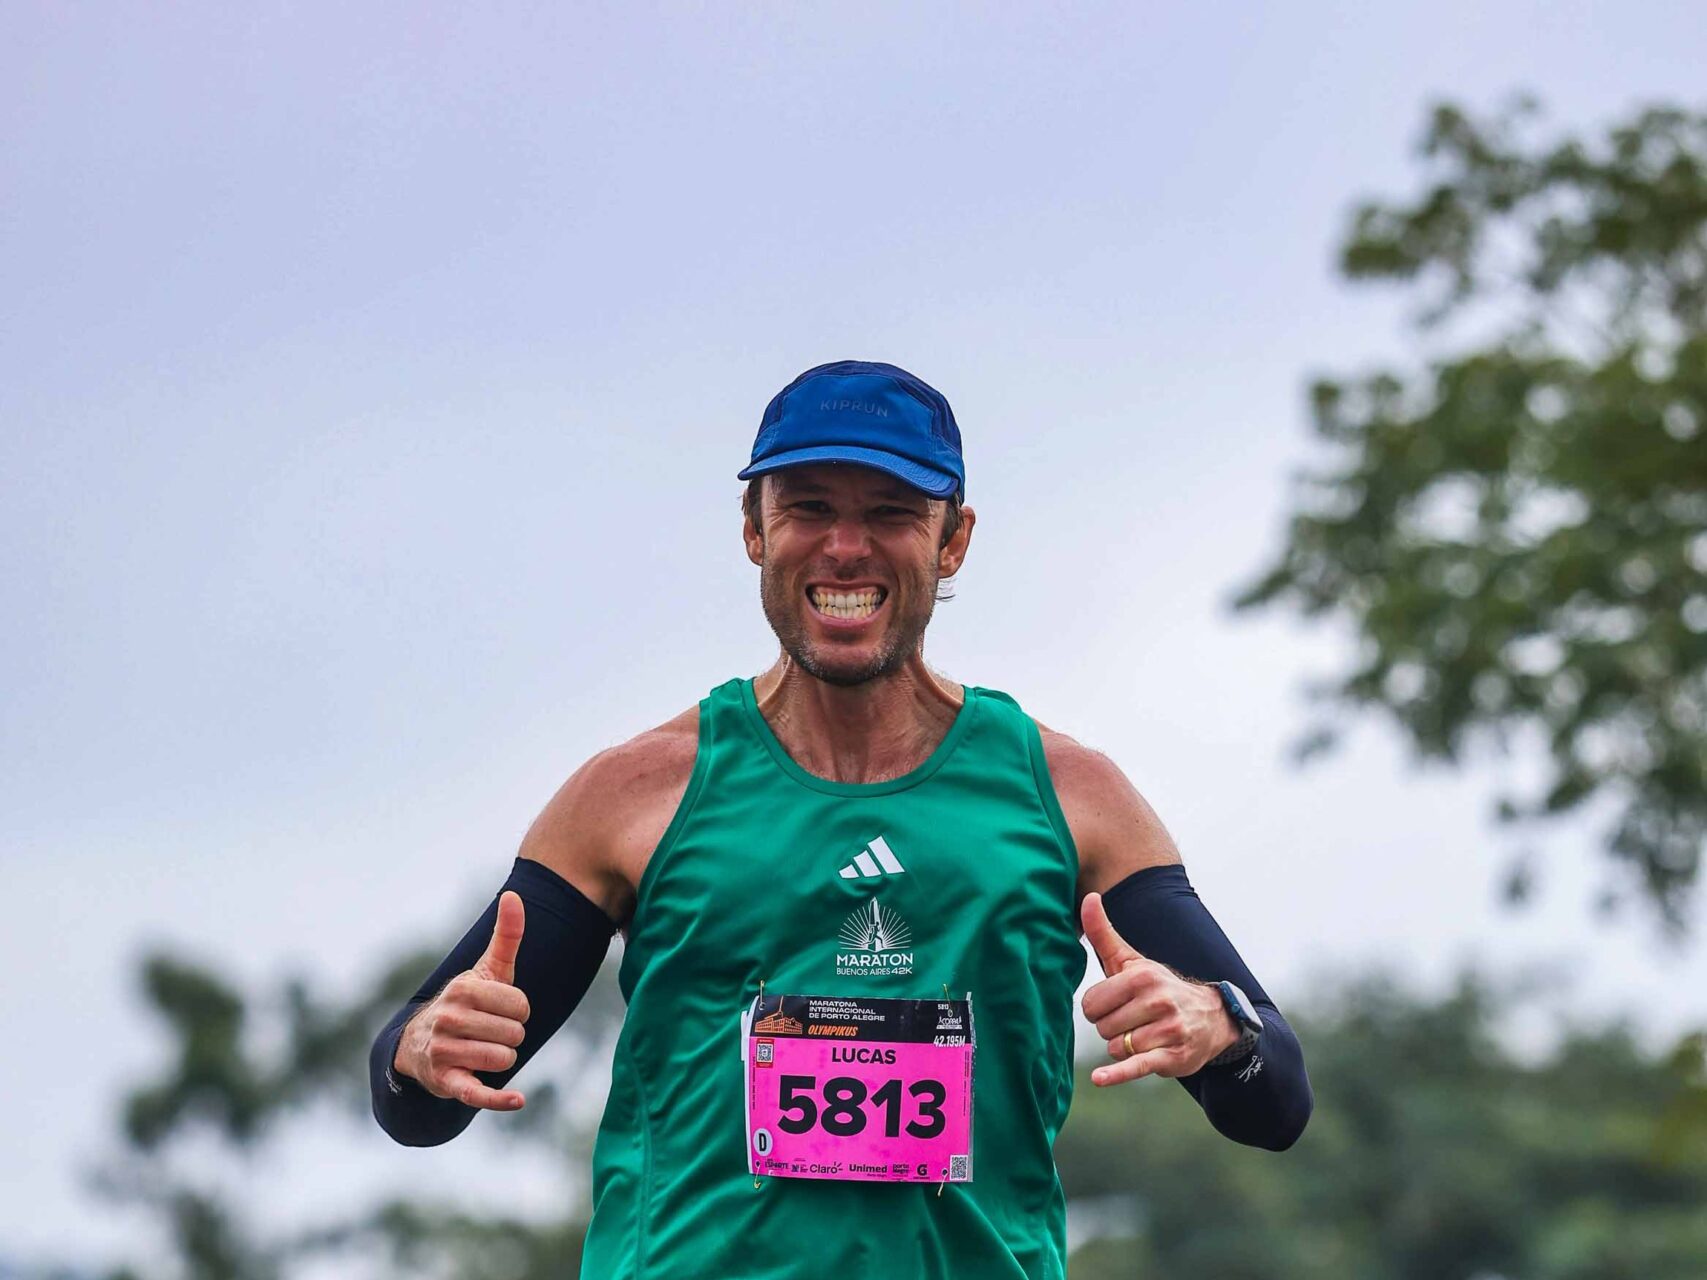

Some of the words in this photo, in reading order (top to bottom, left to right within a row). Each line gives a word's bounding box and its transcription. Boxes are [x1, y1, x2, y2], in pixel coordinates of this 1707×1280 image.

[819, 399, 888, 418] KIPRUN
[836, 952, 913, 967] MARATON
[836, 967, 868, 976] BUENOS
[869, 967, 890, 976] AIRES
[891, 966, 913, 975] 42K
[809, 1000, 858, 1008] MARATONA
[809, 1006, 876, 1015] INTERNACIONAL
[808, 1024, 858, 1037] OLYMPIKUS
[933, 1035, 966, 1048] 42.195M
[831, 1047, 897, 1065] LUCAS
[777, 1074, 947, 1139] 5813
[758, 1132, 767, 1151] D
[810, 1164, 838, 1174] Claro
[849, 1163, 888, 1174] Unimed
